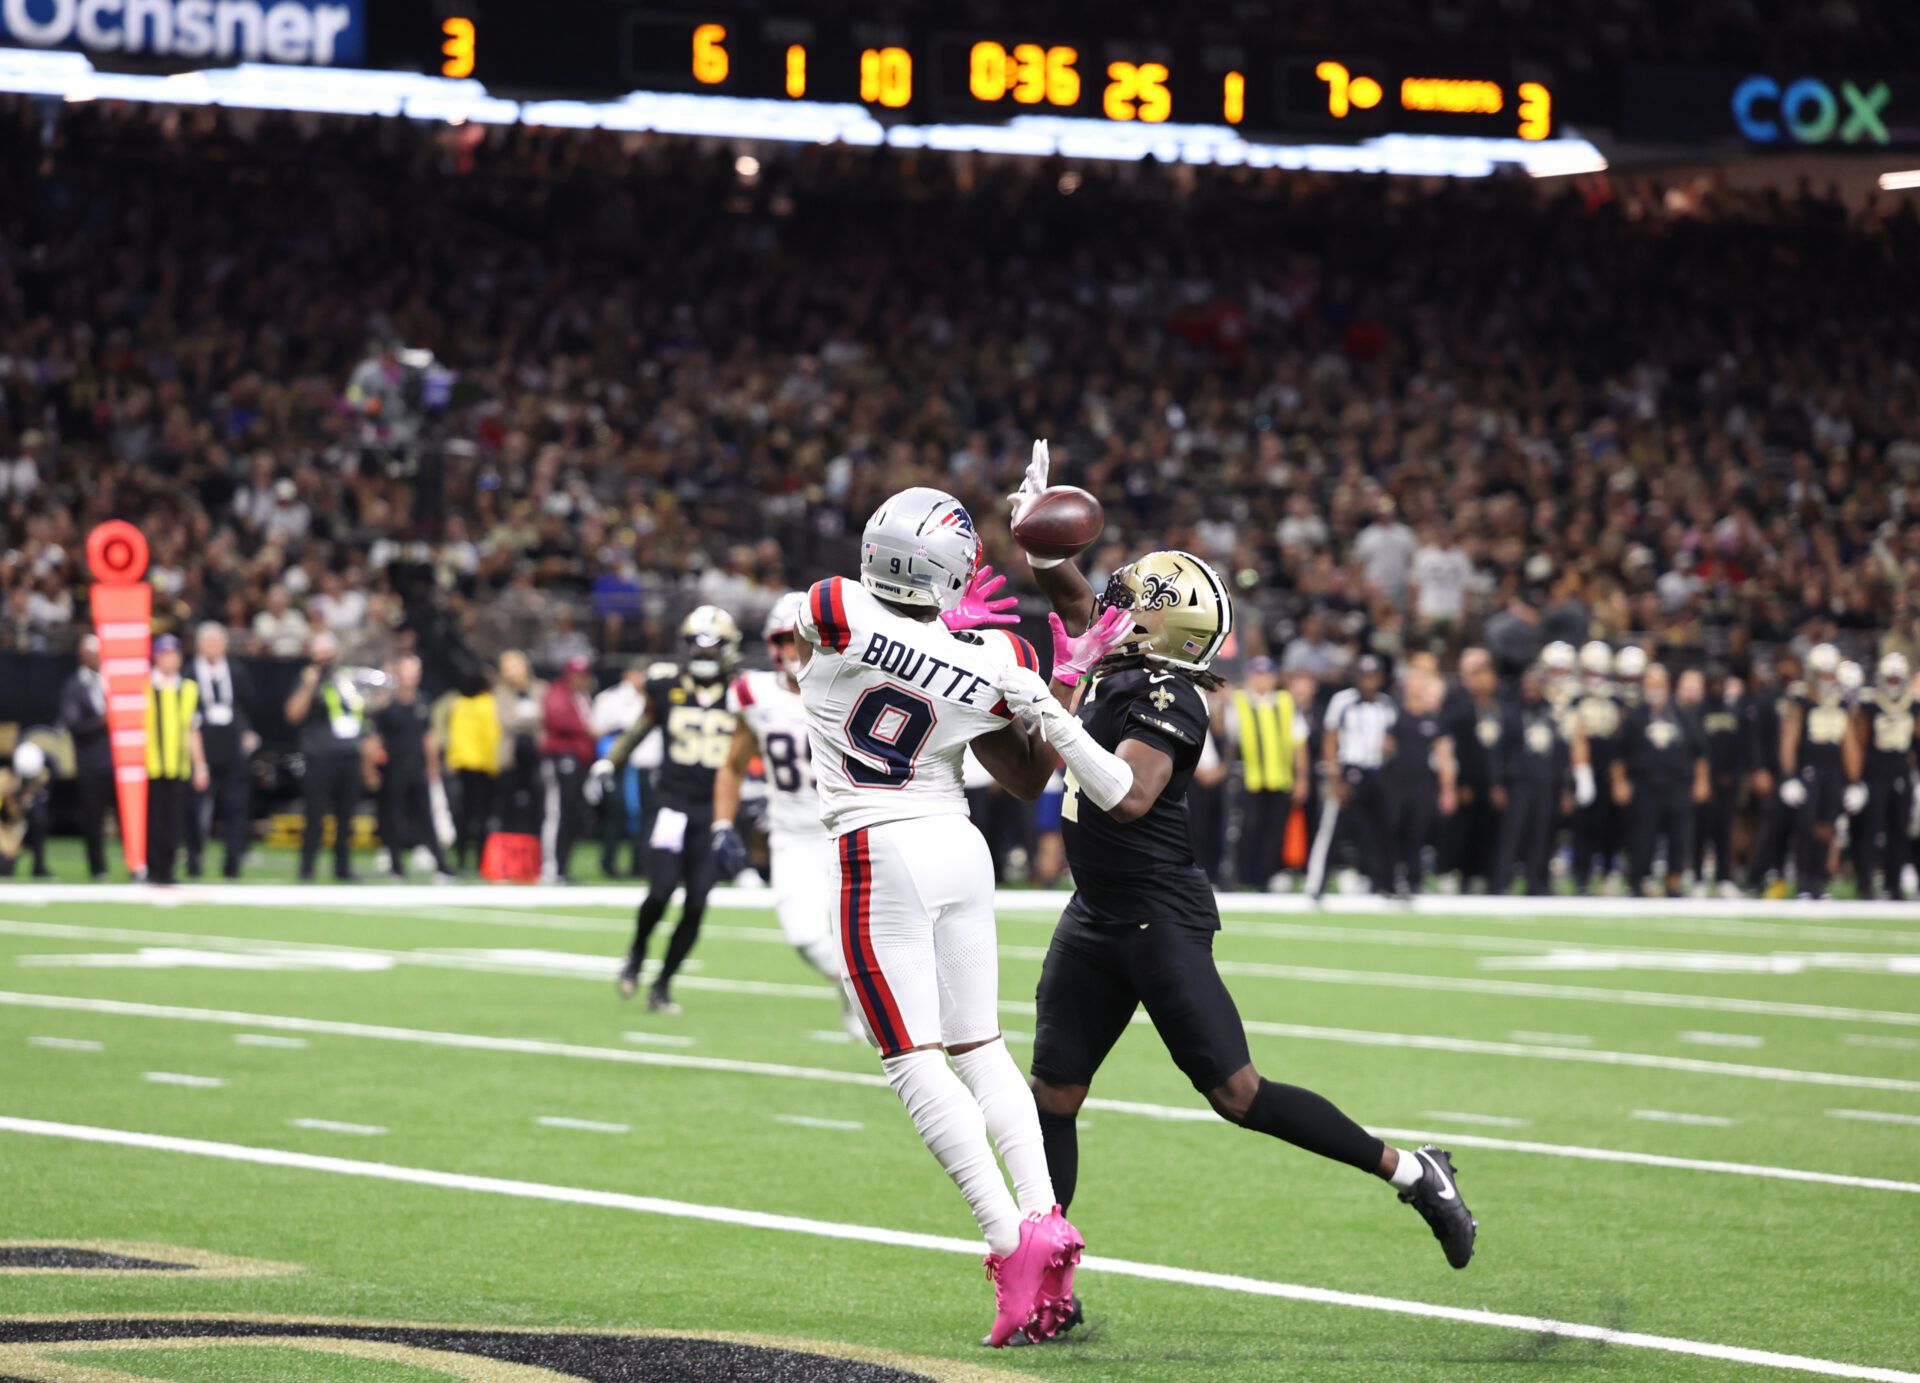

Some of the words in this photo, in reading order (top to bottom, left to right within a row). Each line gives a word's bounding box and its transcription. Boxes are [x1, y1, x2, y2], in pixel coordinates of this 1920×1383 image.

[2, 0, 350, 65] Ochsner
[442, 17, 476, 79] 3
[692, 23, 729, 84] 6
[786, 44, 806, 98] 1
[860, 47, 913, 108] 10
[1103, 61, 1172, 123] 25
[1223, 71, 1245, 124] 1
[1517, 82, 1551, 140] 3
[1732, 75, 1891, 143] COX
[889, 557, 901, 575] 9
[861, 632, 990, 705] BOUTTE
[667, 706, 738, 769] 56
[842, 681, 937, 790] 9
